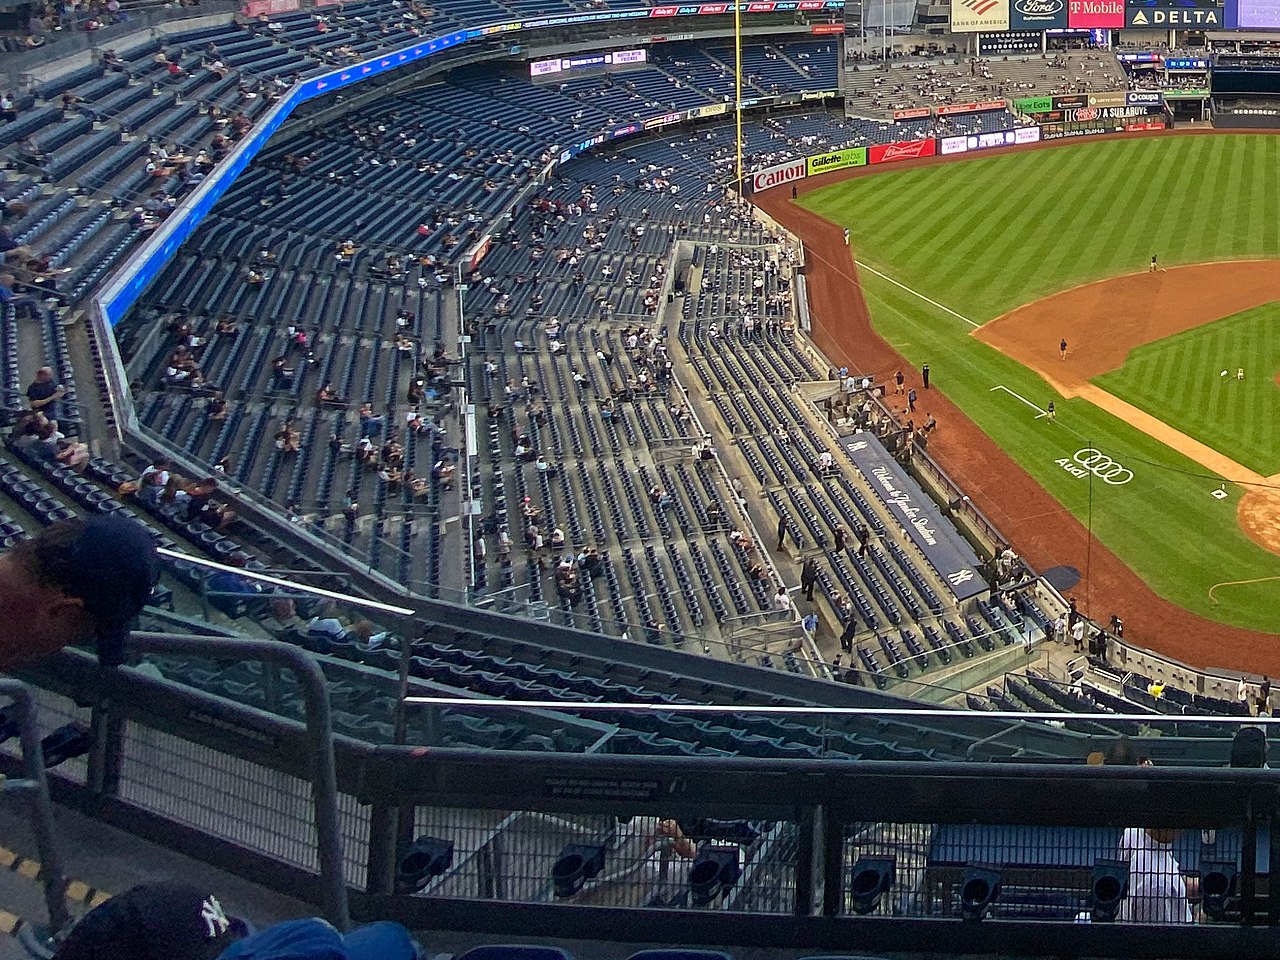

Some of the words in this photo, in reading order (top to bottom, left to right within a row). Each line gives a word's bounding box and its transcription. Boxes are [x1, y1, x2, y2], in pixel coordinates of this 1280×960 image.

[1083, 1, 1123, 14] Mobile
[1154, 11, 1218, 24] DELTA
[1138, 93, 1159, 102] coupa
[1034, 100, 1050, 110] Eats
[1110, 107, 1125, 117] SUB
[1125, 106, 1148, 116] ABOVE
[887, 145, 922, 157] Budweiser
[812, 155, 842, 167] Gillette
[755, 164, 805, 189] Canon
[1055, 457, 1090, 480] Audi
[201, 894, 230, 938] NY
